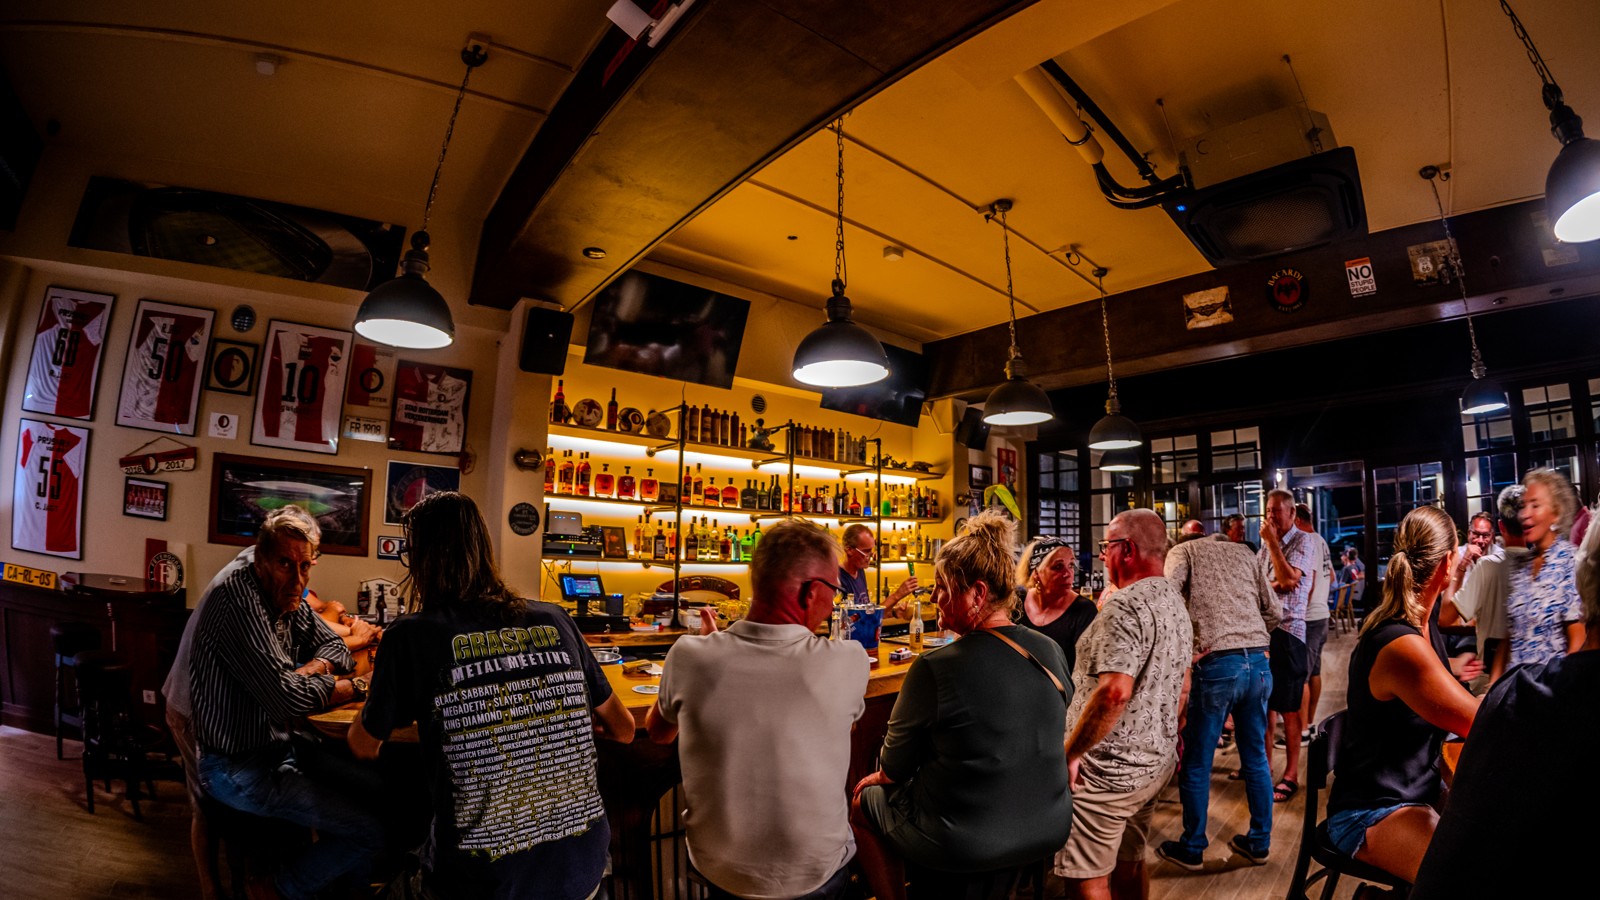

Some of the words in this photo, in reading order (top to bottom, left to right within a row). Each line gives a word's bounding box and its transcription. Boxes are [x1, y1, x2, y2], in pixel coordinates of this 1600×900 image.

[1267, 268, 1303, 287] BACARDI
[1348, 265, 1371, 281] NO
[1351, 279, 1373, 287] STUPID
[1351, 284, 1375, 293] PEOPLE
[148, 337, 184, 382] 50
[281, 362, 319, 404] 10
[404, 404, 418, 412] STAD
[419, 405, 448, 417] ROTTERDAM
[350, 422, 361, 432] FR
[363, 423, 381, 434] 1908
[37, 456, 62, 500] 55
[125, 466, 143, 475] 2016
[165, 460, 186, 470] 2017
[7, 566, 51, 586] CA-RL-OS
[451, 625, 560, 664] GRASPOP
[451, 657, 502, 684] METAL
[508, 651, 572, 670] MEETING
[434, 691, 460, 707] BLACK
[461, 684, 500, 700] SABBATH
[506, 677, 541, 692] VOLBEAT
[546, 673, 565, 684] IRON
[442, 699, 487, 717] MEGADETH
[493, 693, 524, 707] SLAYER
[530, 684, 566, 701] TWISTED
[566, 682, 584, 694] SISTER
[443, 718, 461, 730] KING
[462, 710, 502, 727] DIAMOND
[510, 699, 557, 718] NIGHTWISH
[450, 734, 465, 742] AMON
[465, 729, 490, 740] AMARTH
[494, 722, 525, 734] DISTURBED
[528, 717, 545, 728] GHOST
[550, 713, 567, 722] GOJIRA
[465, 737, 494, 749] MURPHYS
[497, 733, 517, 744] BULLET
[518, 730, 529, 739] FOR
[529, 728, 538, 737] MY
[538, 722, 565, 734] VALENTINE
[447, 750, 477, 761] ILLSWITCH
[476, 745, 499, 757] ENGAGE
[548, 729, 574, 741] FOREIGNER
[474, 758, 485, 766] BAD
[485, 754, 507, 764] RELIGION
[510, 746, 536, 758] TESTAMENT
[473, 763, 503, 775] POWERWOLF
[490, 844, 515, 857] 17-18-19
[516, 840, 529, 850] JUNE
